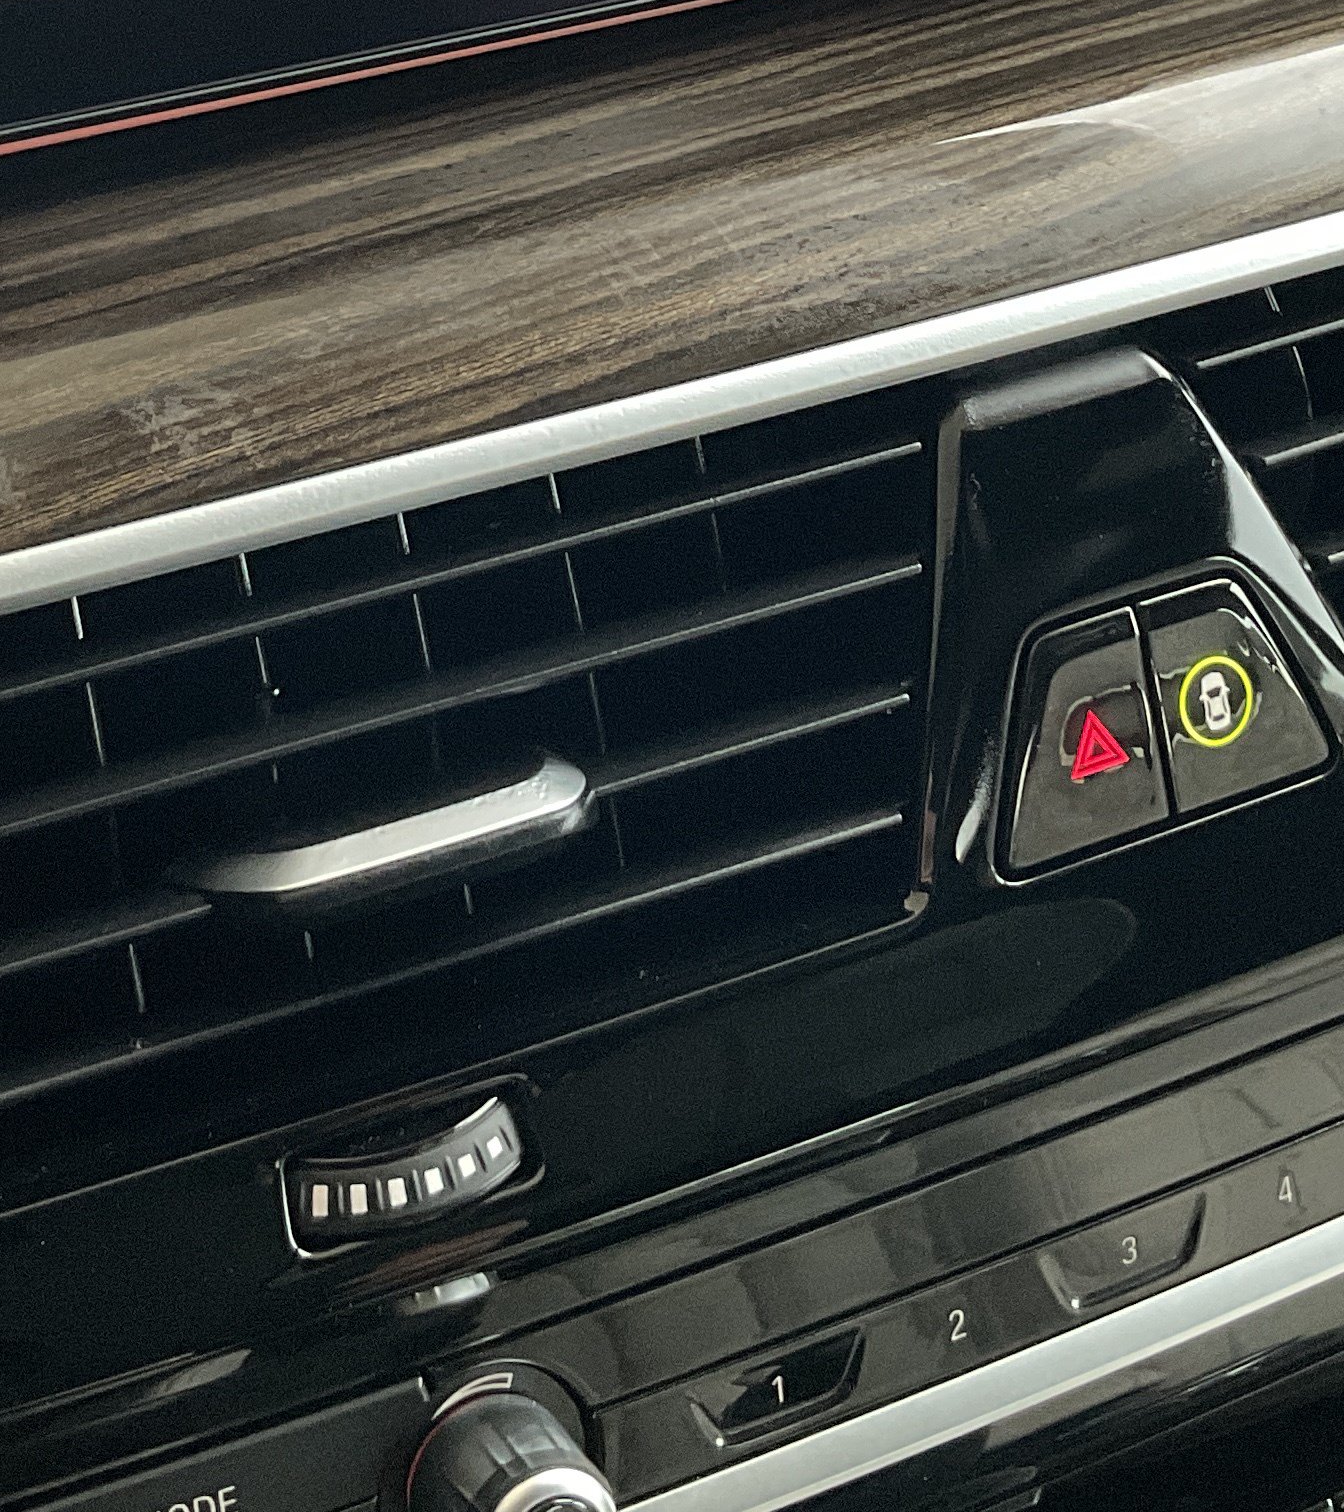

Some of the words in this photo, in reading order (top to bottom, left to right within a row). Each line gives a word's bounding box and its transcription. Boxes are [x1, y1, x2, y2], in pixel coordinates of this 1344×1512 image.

[1278, 1175, 1294, 1204] 4
[1121, 1236, 1139, 1265] 3
[948, 1310, 967, 1341] 2
[770, 1374, 785, 1403] 1
